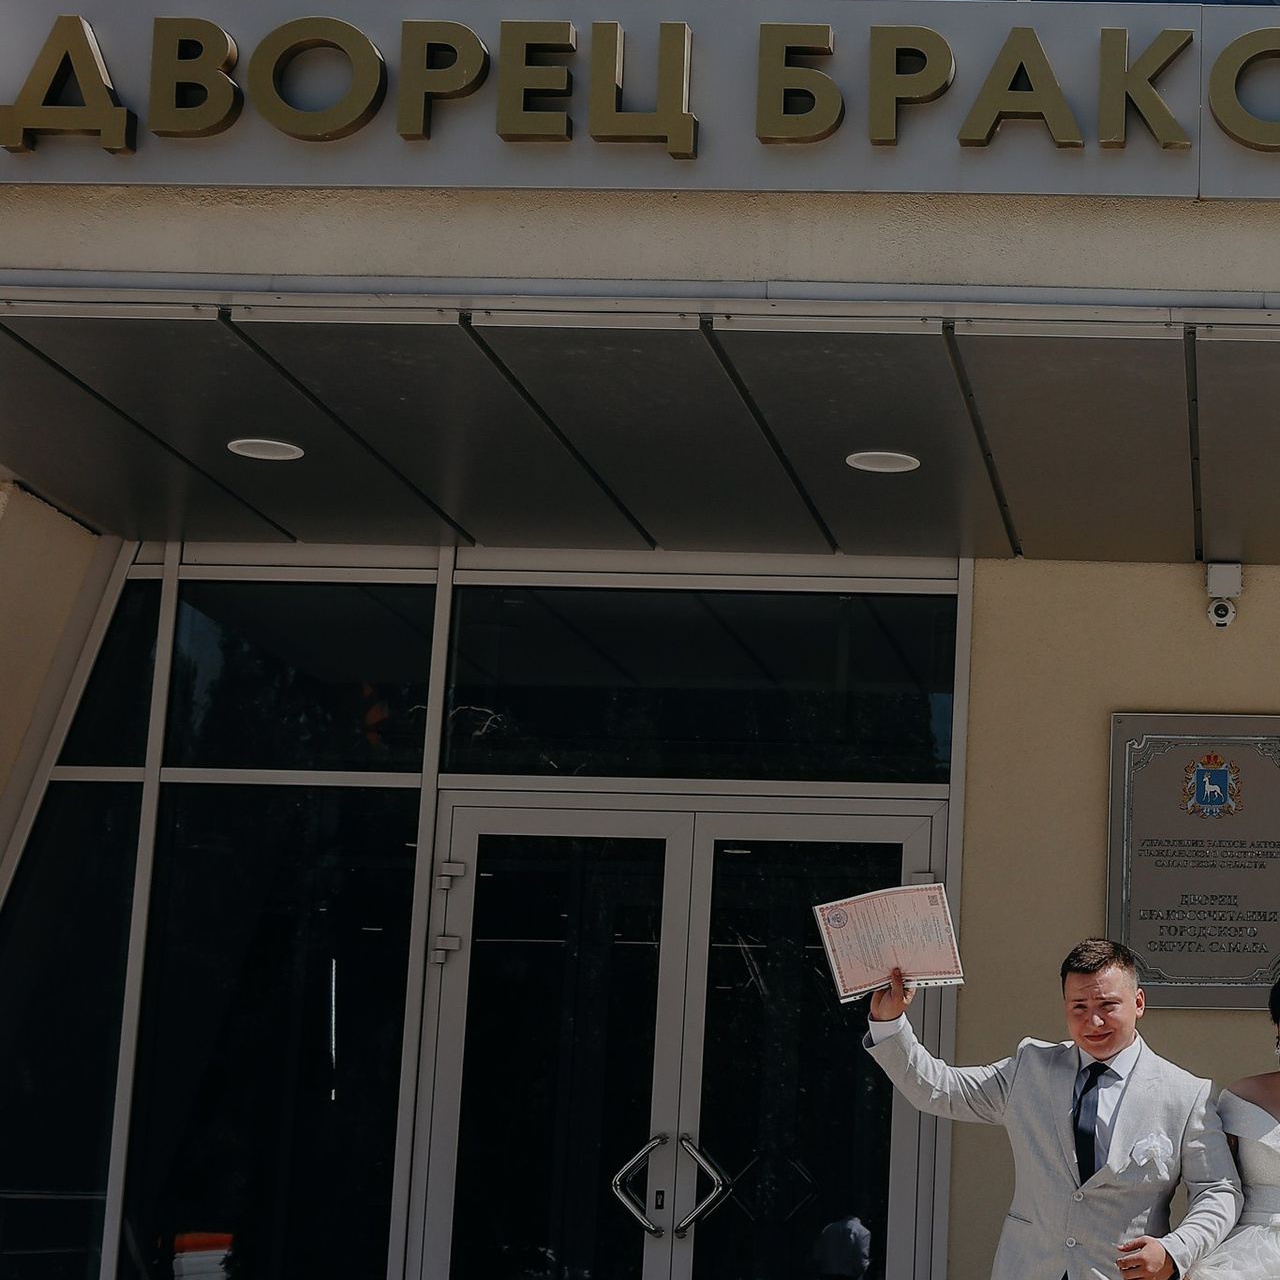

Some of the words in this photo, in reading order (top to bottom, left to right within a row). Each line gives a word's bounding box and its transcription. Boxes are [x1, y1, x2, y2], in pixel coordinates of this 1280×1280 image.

[0, 14, 699, 160] ДВОРЕЦ
[1179, 894, 1239, 908] ДВОРЕЦ
[1139, 909, 1279, 922] БРАКОСОЧЕТАНИЯ
[1158, 925, 1259, 939] ГОРОДСКОГО
[1147, 940, 1205, 952] ОКРУГА
[1209, 941, 1269, 953] САМАРА
